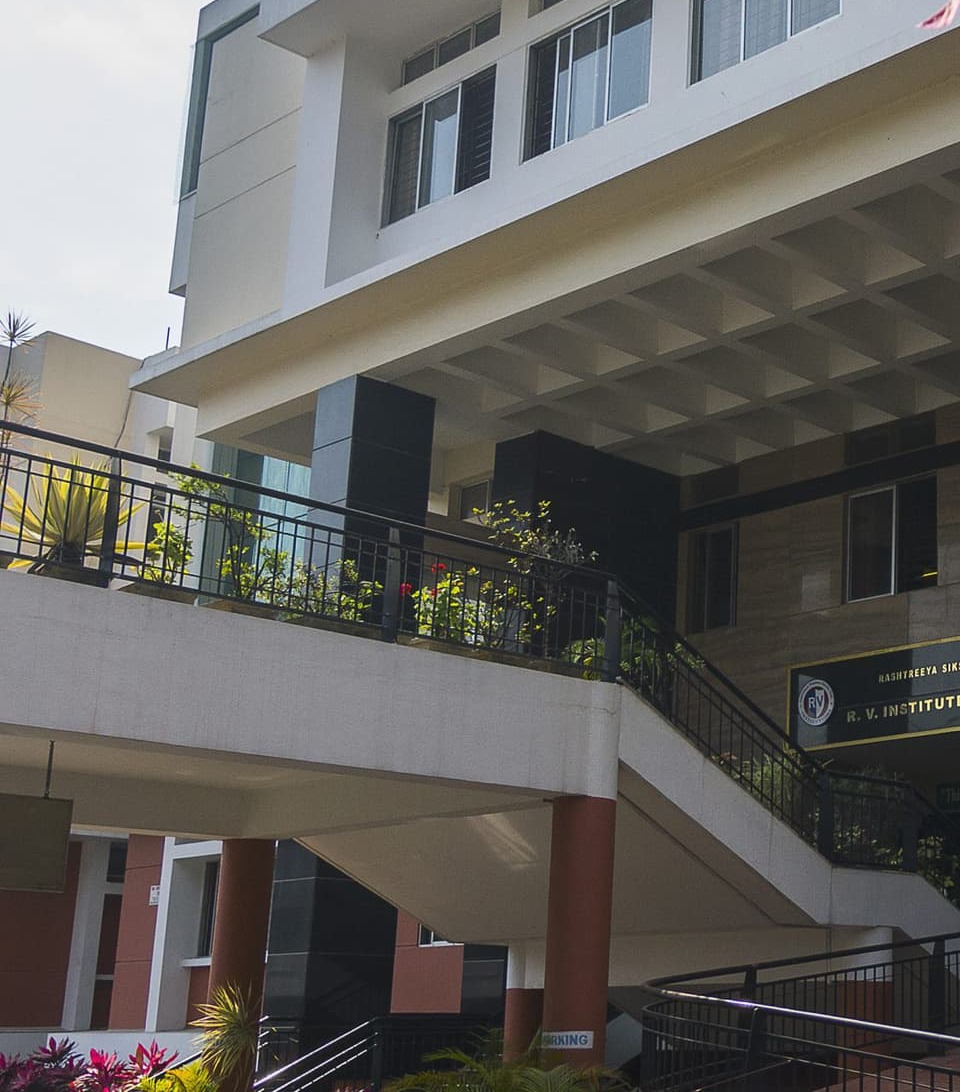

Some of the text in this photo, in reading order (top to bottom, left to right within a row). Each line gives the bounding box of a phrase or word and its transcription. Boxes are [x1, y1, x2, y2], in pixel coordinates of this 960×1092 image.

[878, 666, 938, 684] RASHTREEYA
[846, 710, 861, 723] R.
[866, 708, 879, 721] V.
